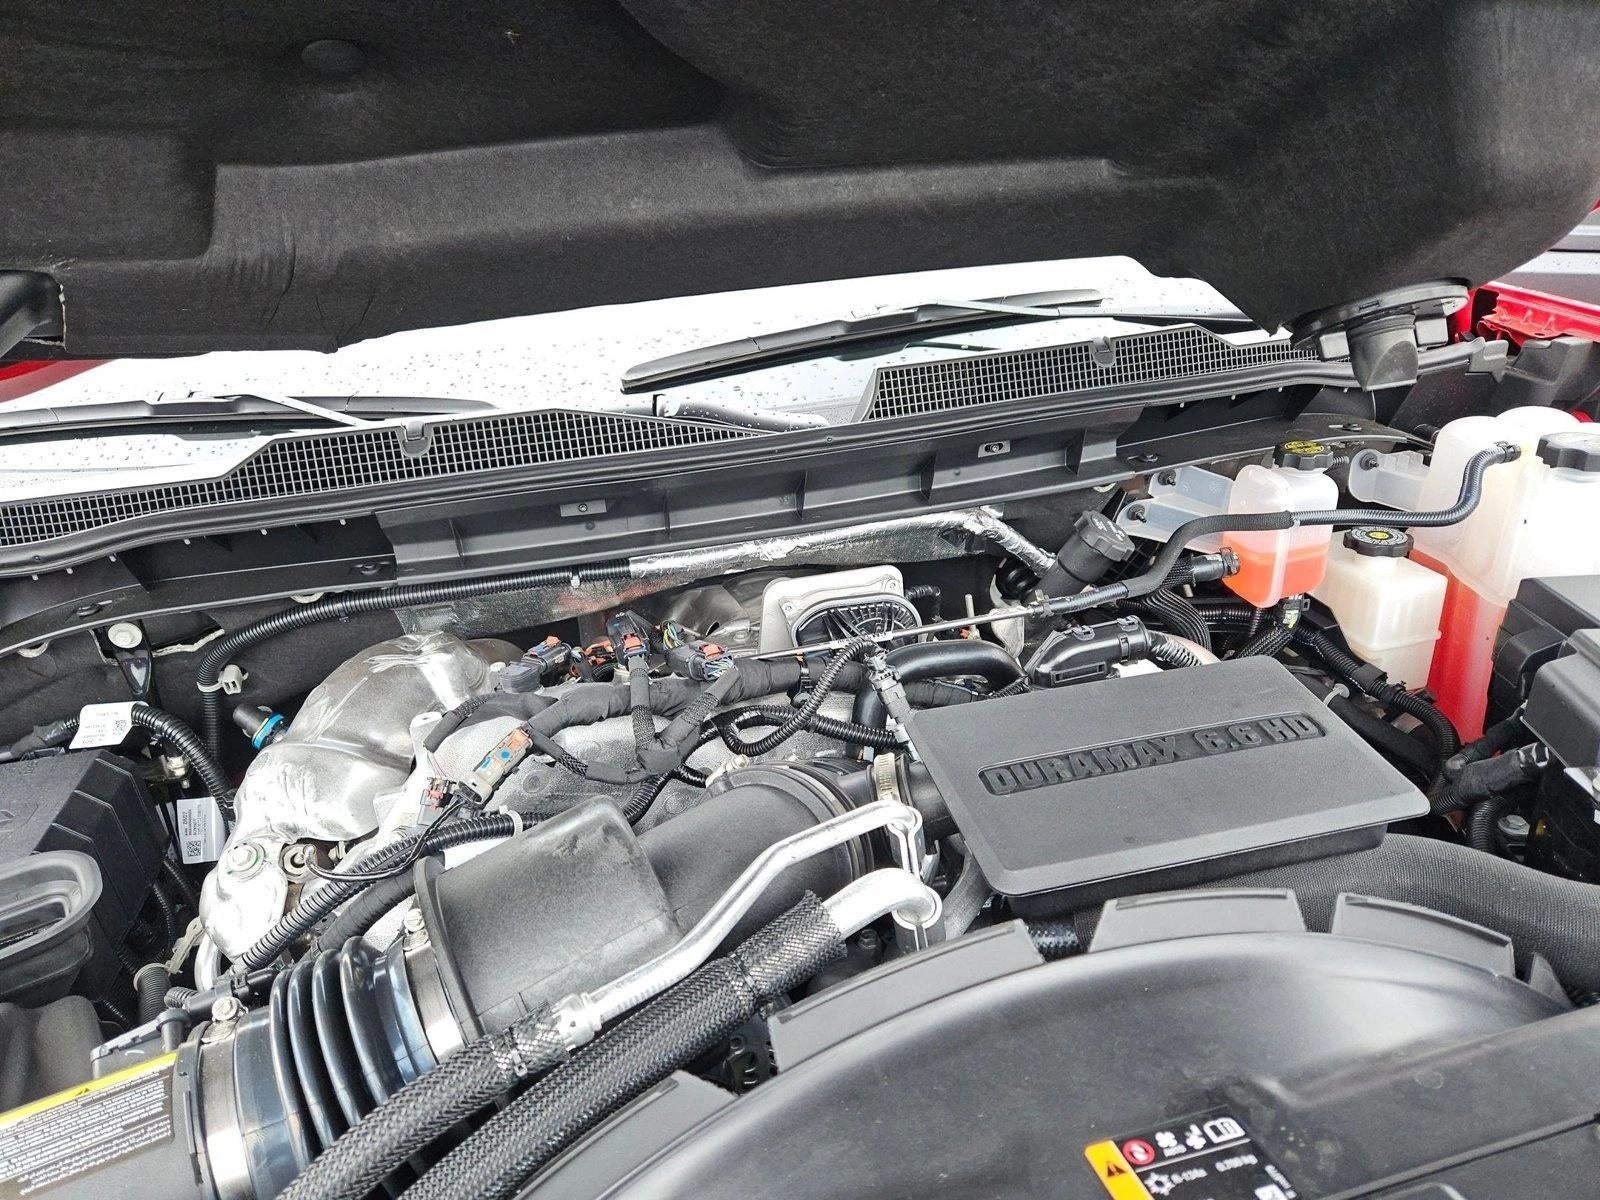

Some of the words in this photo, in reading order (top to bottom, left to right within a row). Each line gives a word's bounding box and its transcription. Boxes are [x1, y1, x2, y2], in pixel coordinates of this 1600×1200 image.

[984, 736, 1190, 794] DURAMAX
[1194, 724, 1262, 753] 6.6
[1257, 715, 1319, 742] HD
